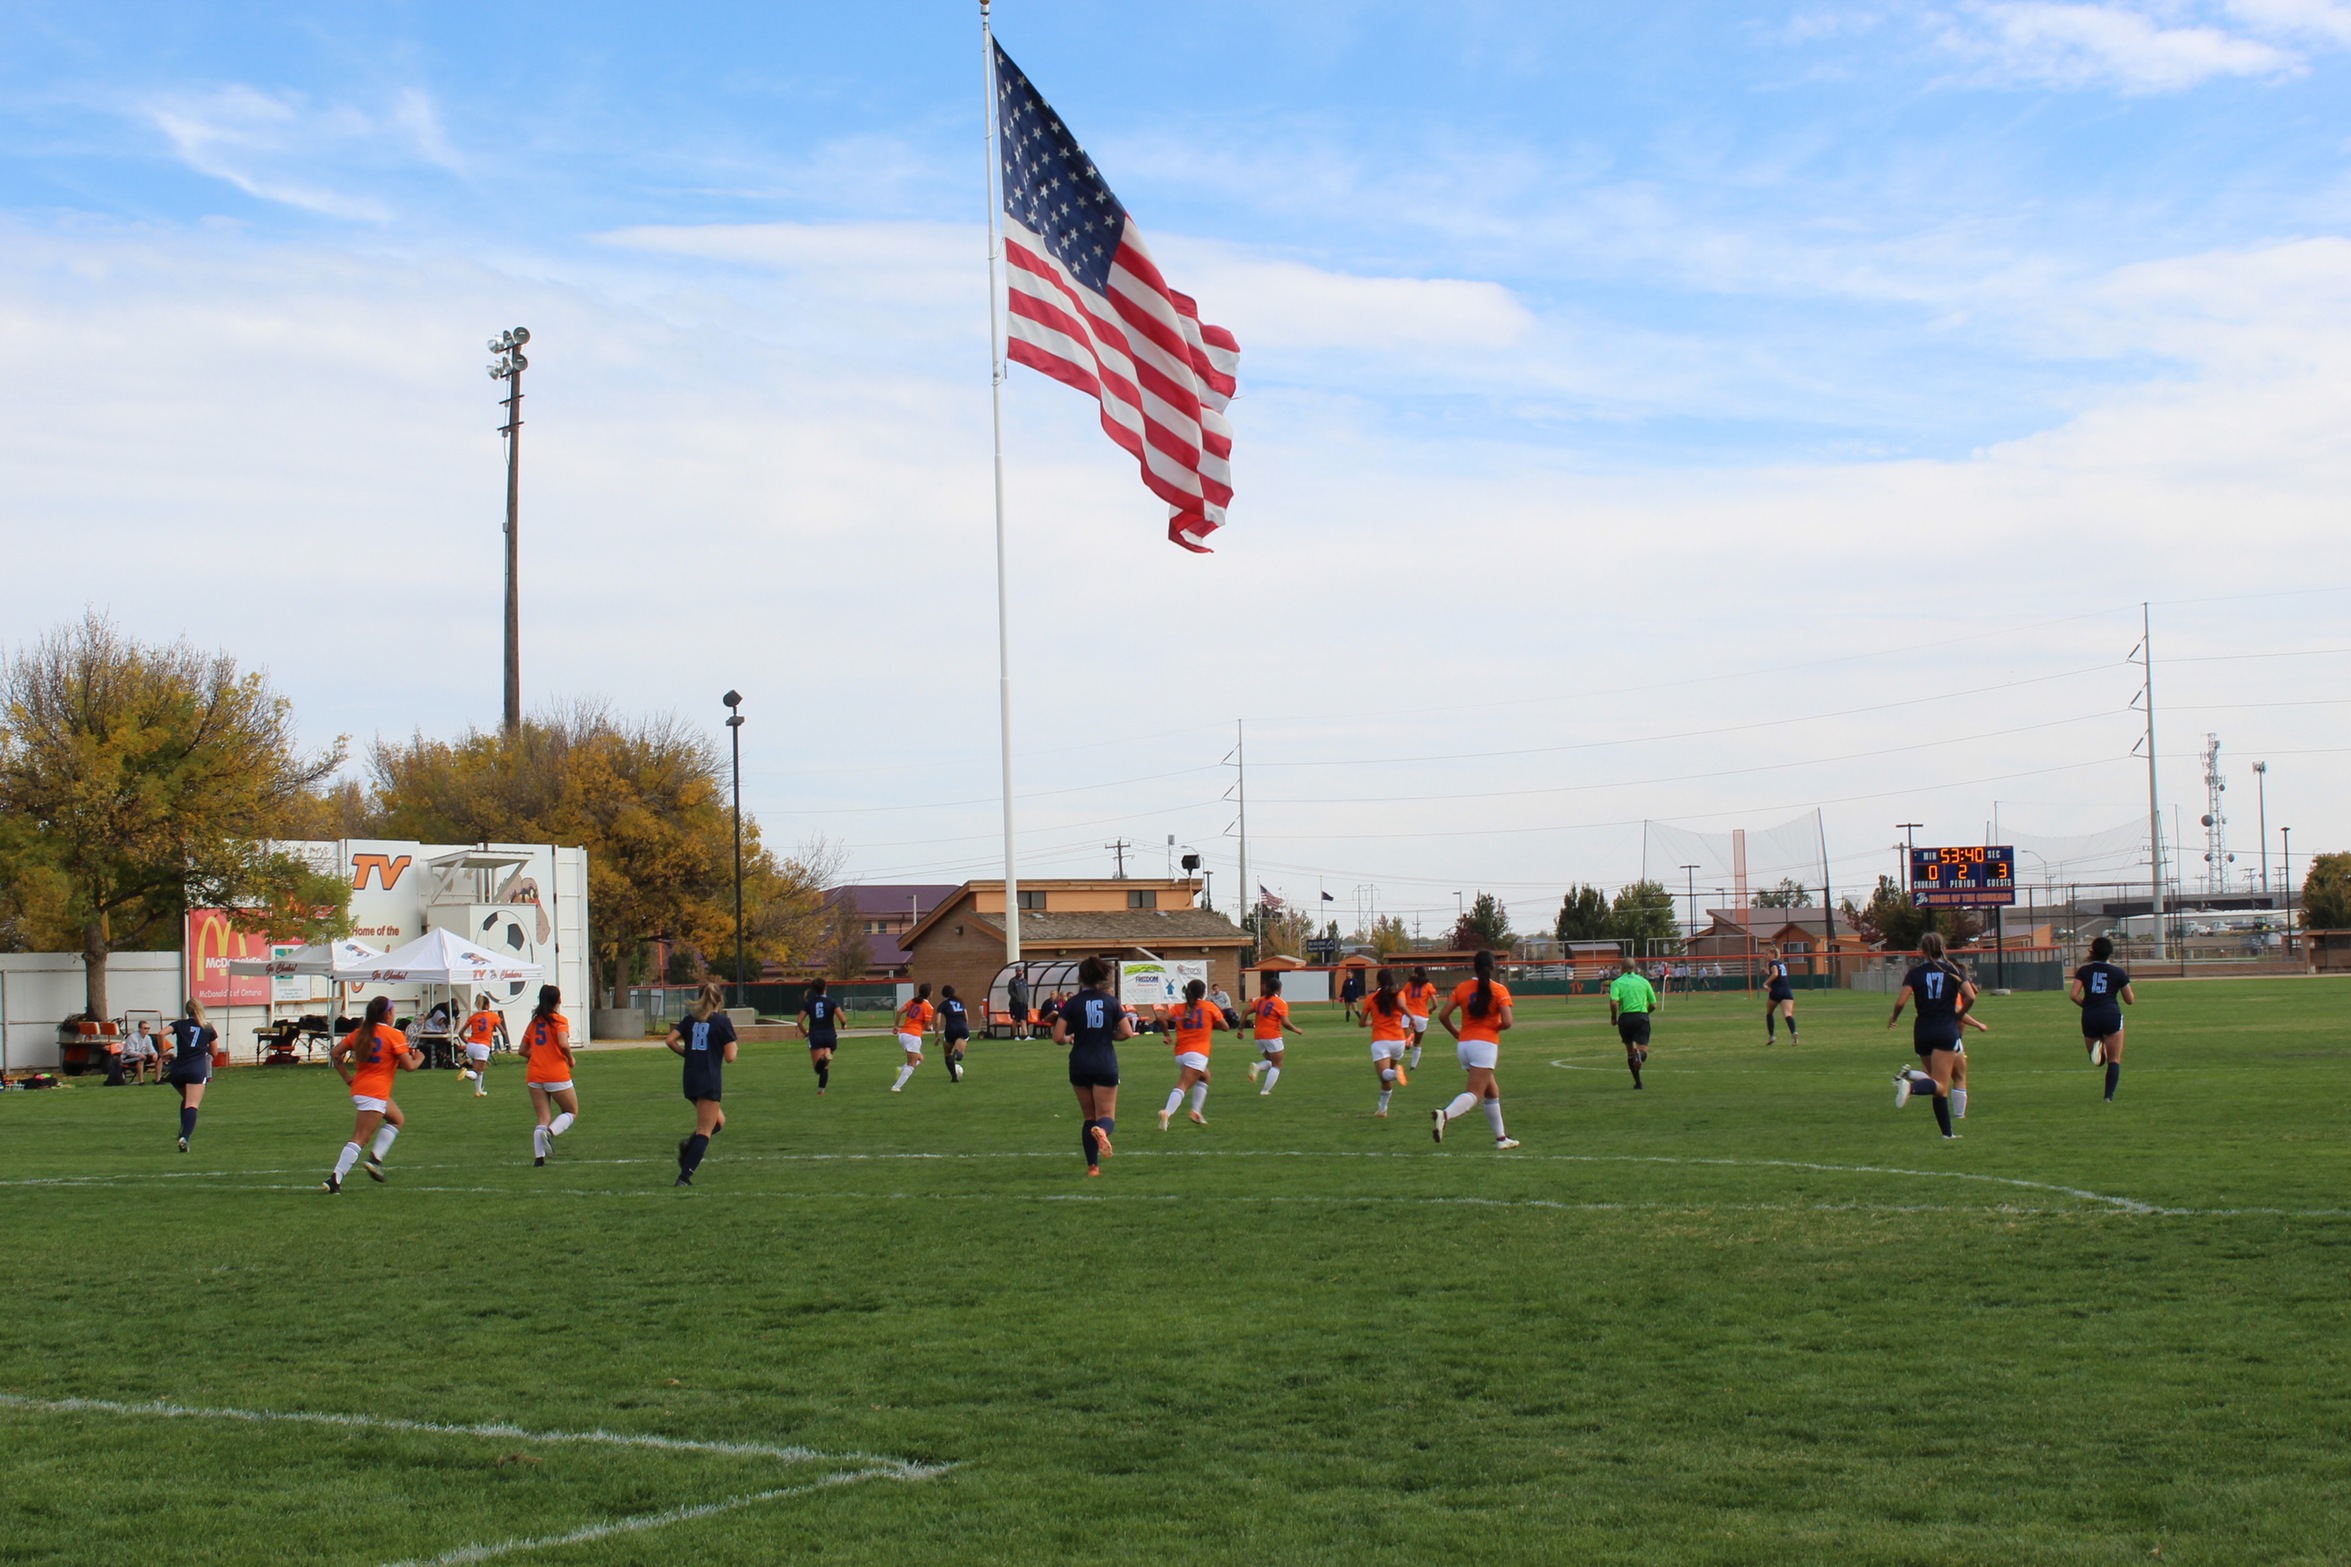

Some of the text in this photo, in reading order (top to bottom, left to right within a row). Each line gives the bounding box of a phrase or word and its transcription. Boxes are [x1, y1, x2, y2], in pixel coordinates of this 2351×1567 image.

[1923, 847, 2001, 864] MIN 53:40 SEC
[351, 853, 412, 891] TV
[1928, 865, 1938, 880] 0
[1958, 864, 1968, 879] 2
[1998, 863, 2008, 879] 3
[1950, 879, 1976, 888] PERIOD
[1986, 878, 2012, 887] GUESTS
[1929, 894, 1950, 903] HOME
[1951, 893, 1961, 903] OF
[1962, 893, 1976, 903] THE
[352, 925, 400, 936] Home of the
[473, 969, 487, 979] TV
[1925, 971, 1944, 999] 17
[2091, 971, 2107, 994] 15
[233, 988, 240, 997] of
[241, 988, 262, 997] Ontario
[815, 1001, 824, 1019] 6
[1085, 999, 1104, 1028] 16
[478, 1017, 488, 1032] 3
[190, 1026, 201, 1047] 7
[535, 1022, 547, 1046] 5
[691, 1021, 710, 1051] 18
